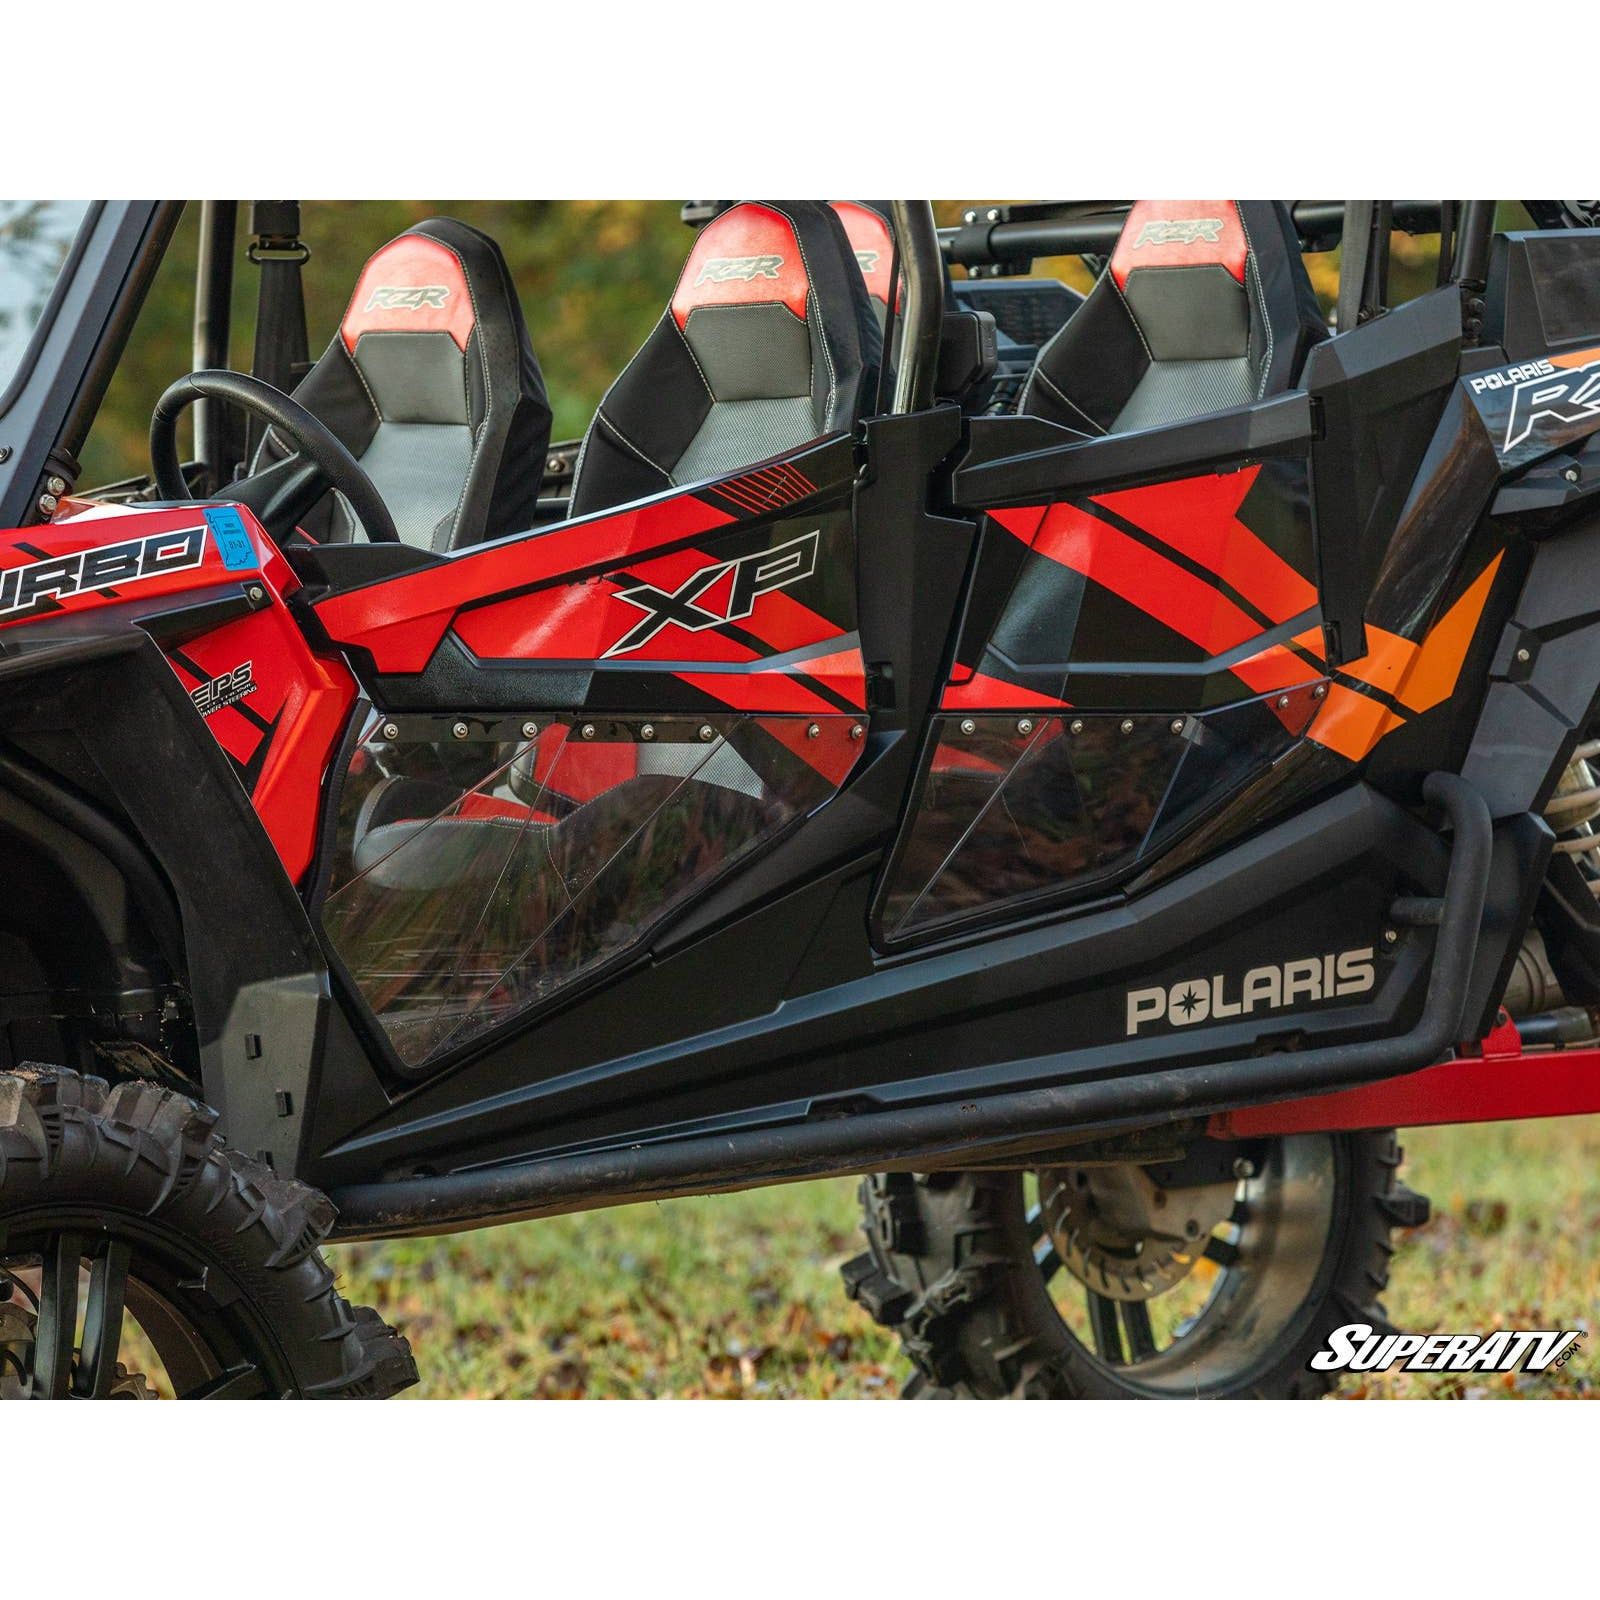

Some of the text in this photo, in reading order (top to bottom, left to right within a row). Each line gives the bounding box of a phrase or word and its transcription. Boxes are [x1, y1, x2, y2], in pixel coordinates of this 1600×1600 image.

[1133, 218, 1224, 249] RZR
[695, 255, 784, 288] RZR
[363, 286, 450, 312] RZR
[1470, 359, 1555, 394] POLARIS
[600, 529, 820, 660] XP
[190, 660, 252, 709] EPS
[1126, 947, 1375, 1036] POLARIS
